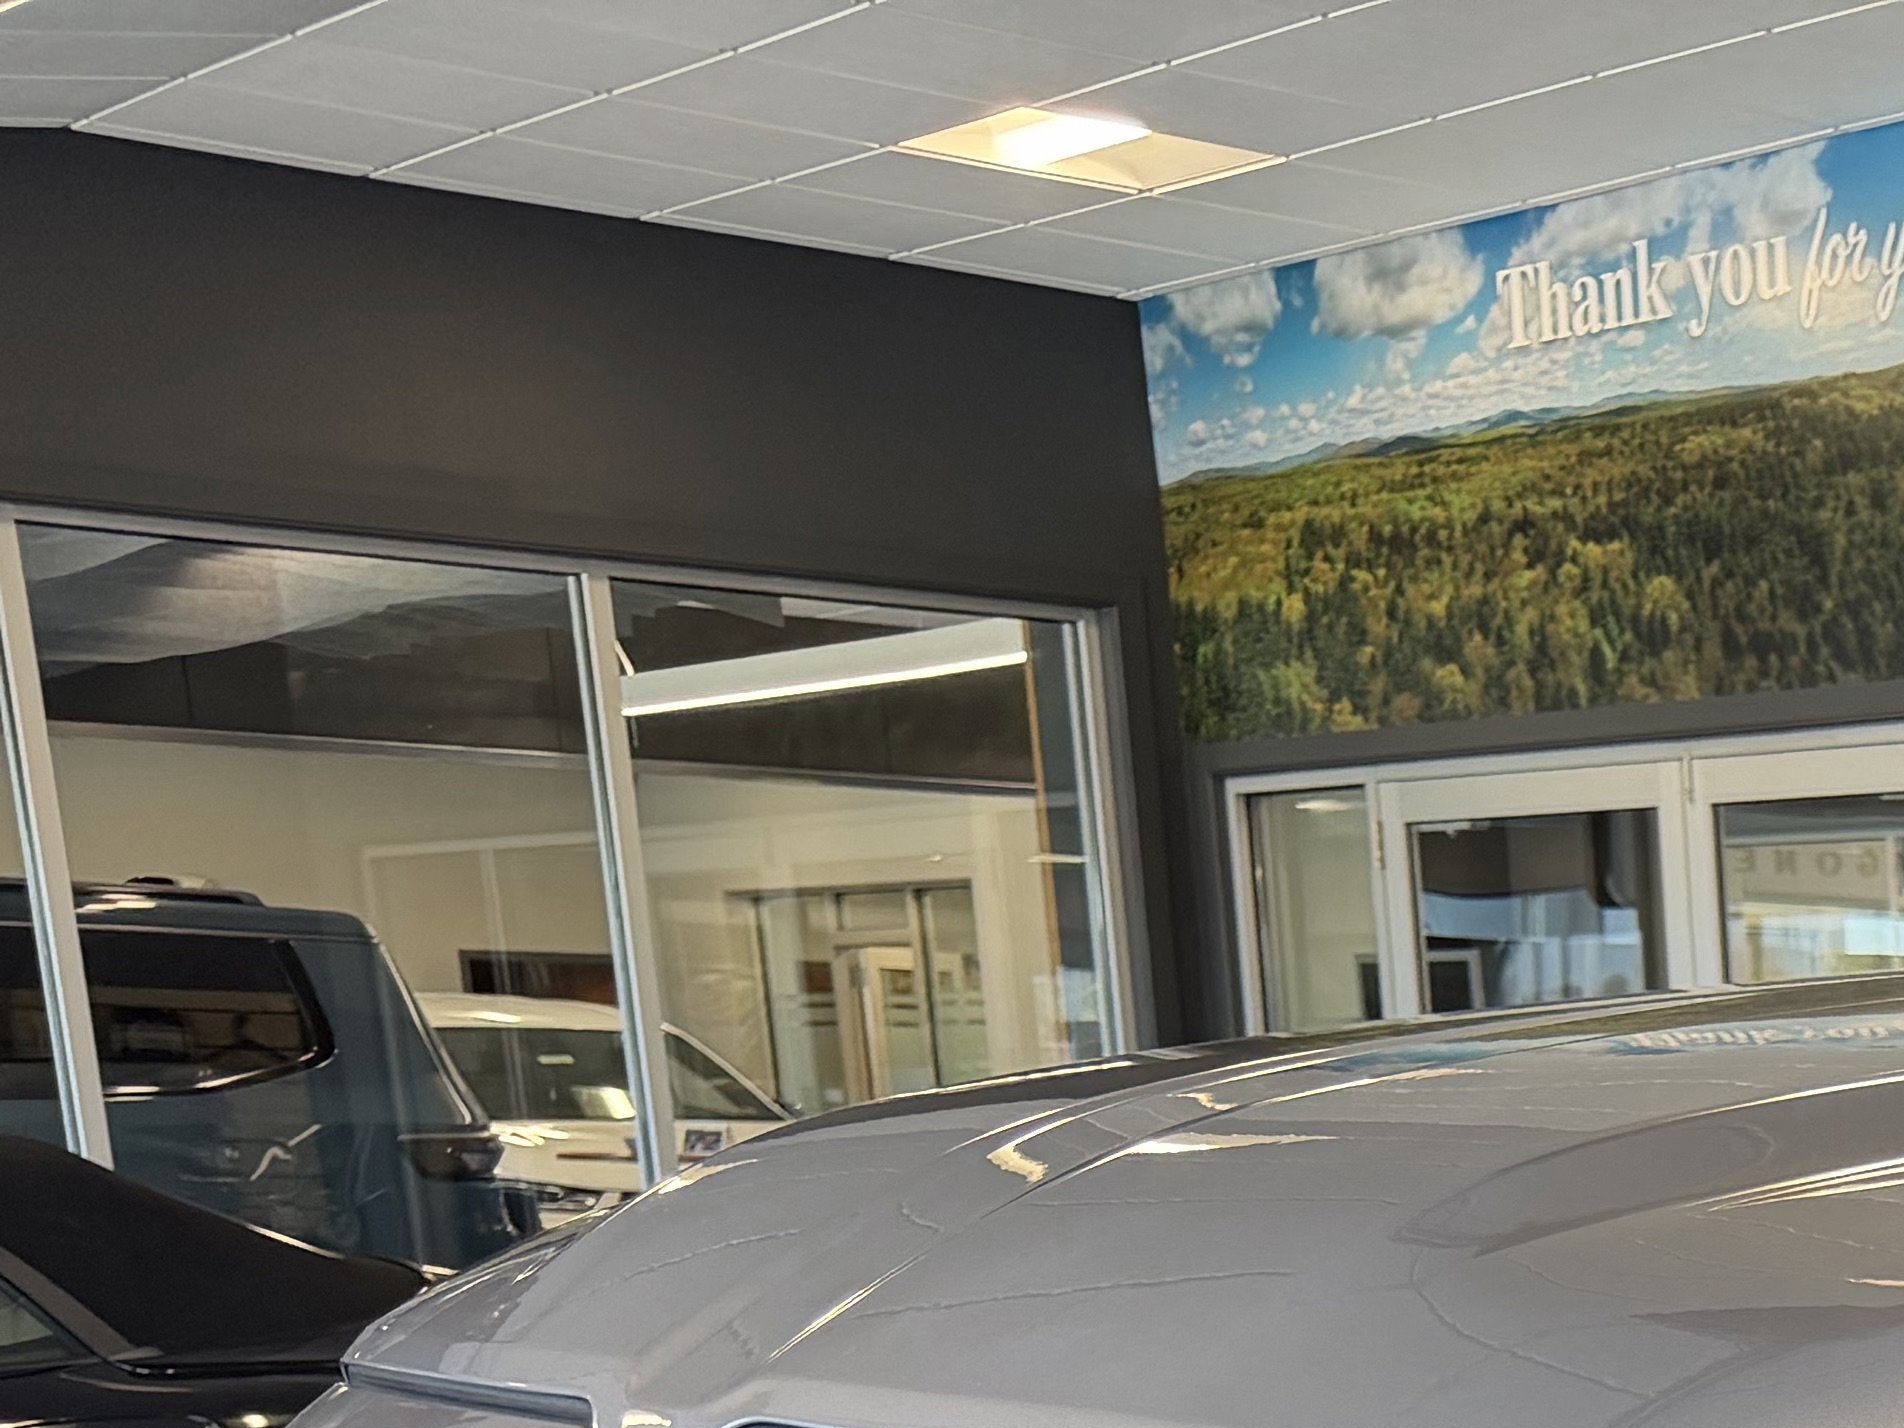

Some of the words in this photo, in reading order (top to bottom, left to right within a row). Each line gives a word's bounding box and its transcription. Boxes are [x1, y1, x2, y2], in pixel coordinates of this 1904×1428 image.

[1495, 238, 1674, 349] Thank
[1687, 234, 1790, 337] you
[1802, 208, 1870, 328] for
